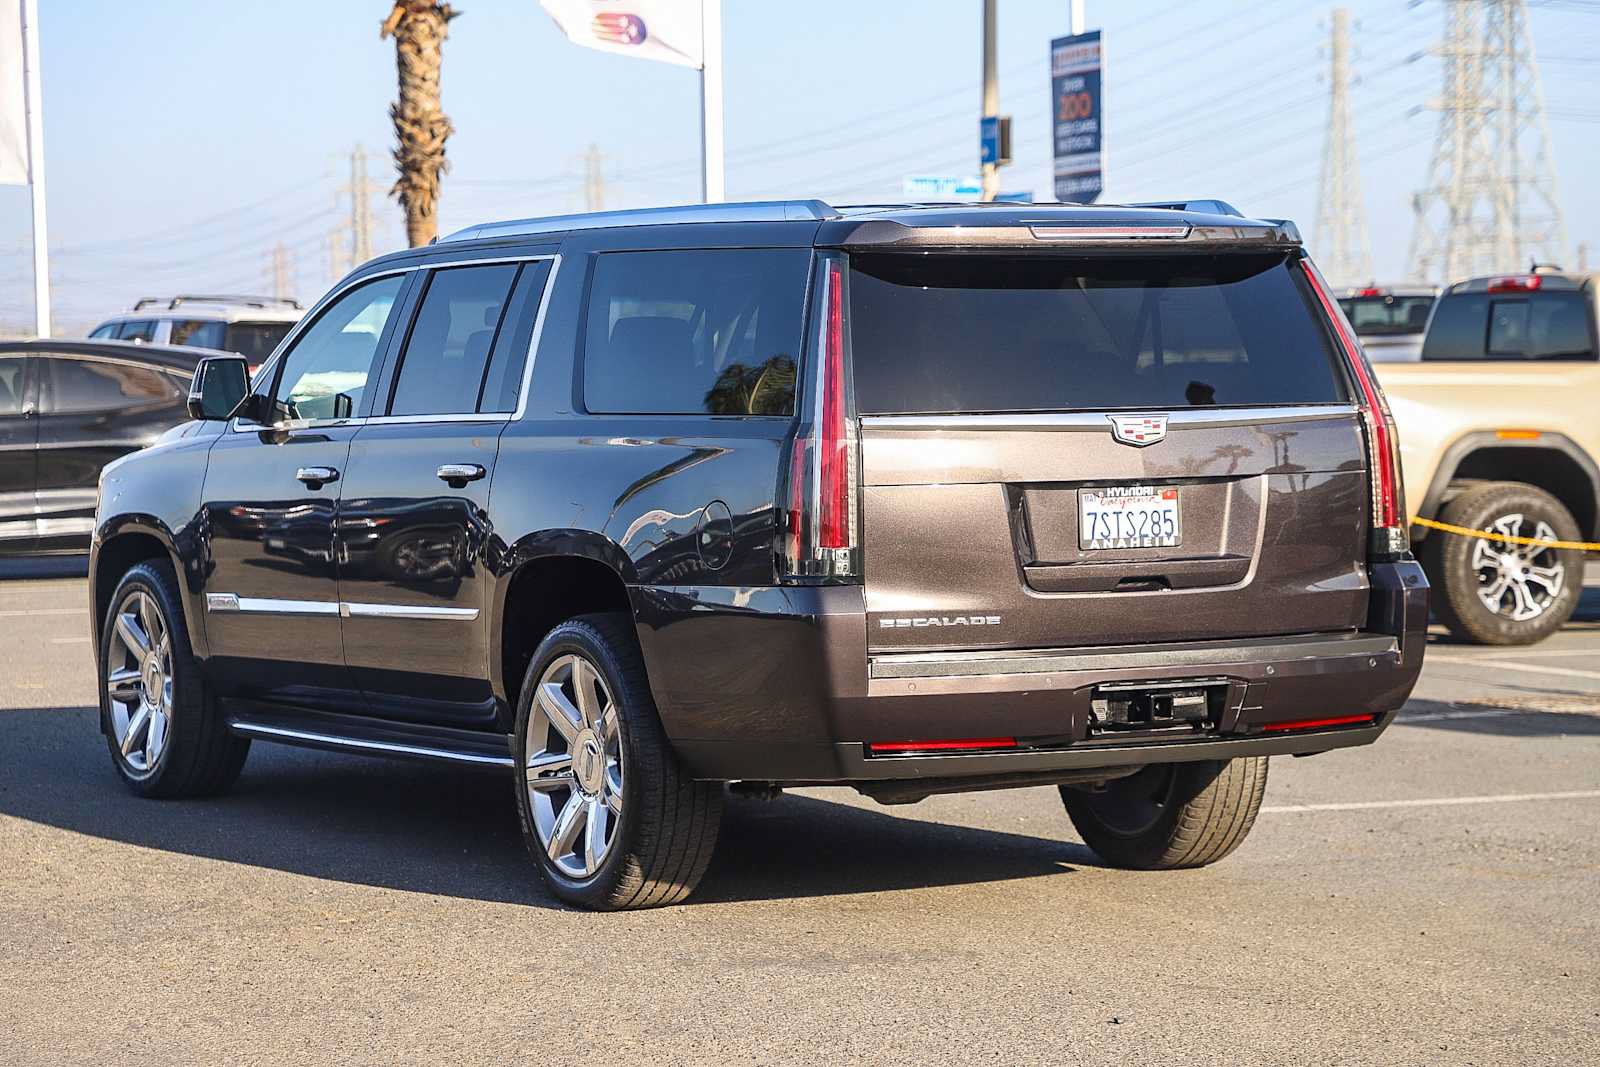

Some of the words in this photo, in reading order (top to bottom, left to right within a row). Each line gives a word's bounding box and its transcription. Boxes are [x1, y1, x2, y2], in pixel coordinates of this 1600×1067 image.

[1107, 486, 1154, 497] HYUNDAI
[1087, 509, 1174, 540] 7STS285
[1090, 536, 1175, 549] ANAHEIM
[879, 616, 1001, 628] ESCALADE
